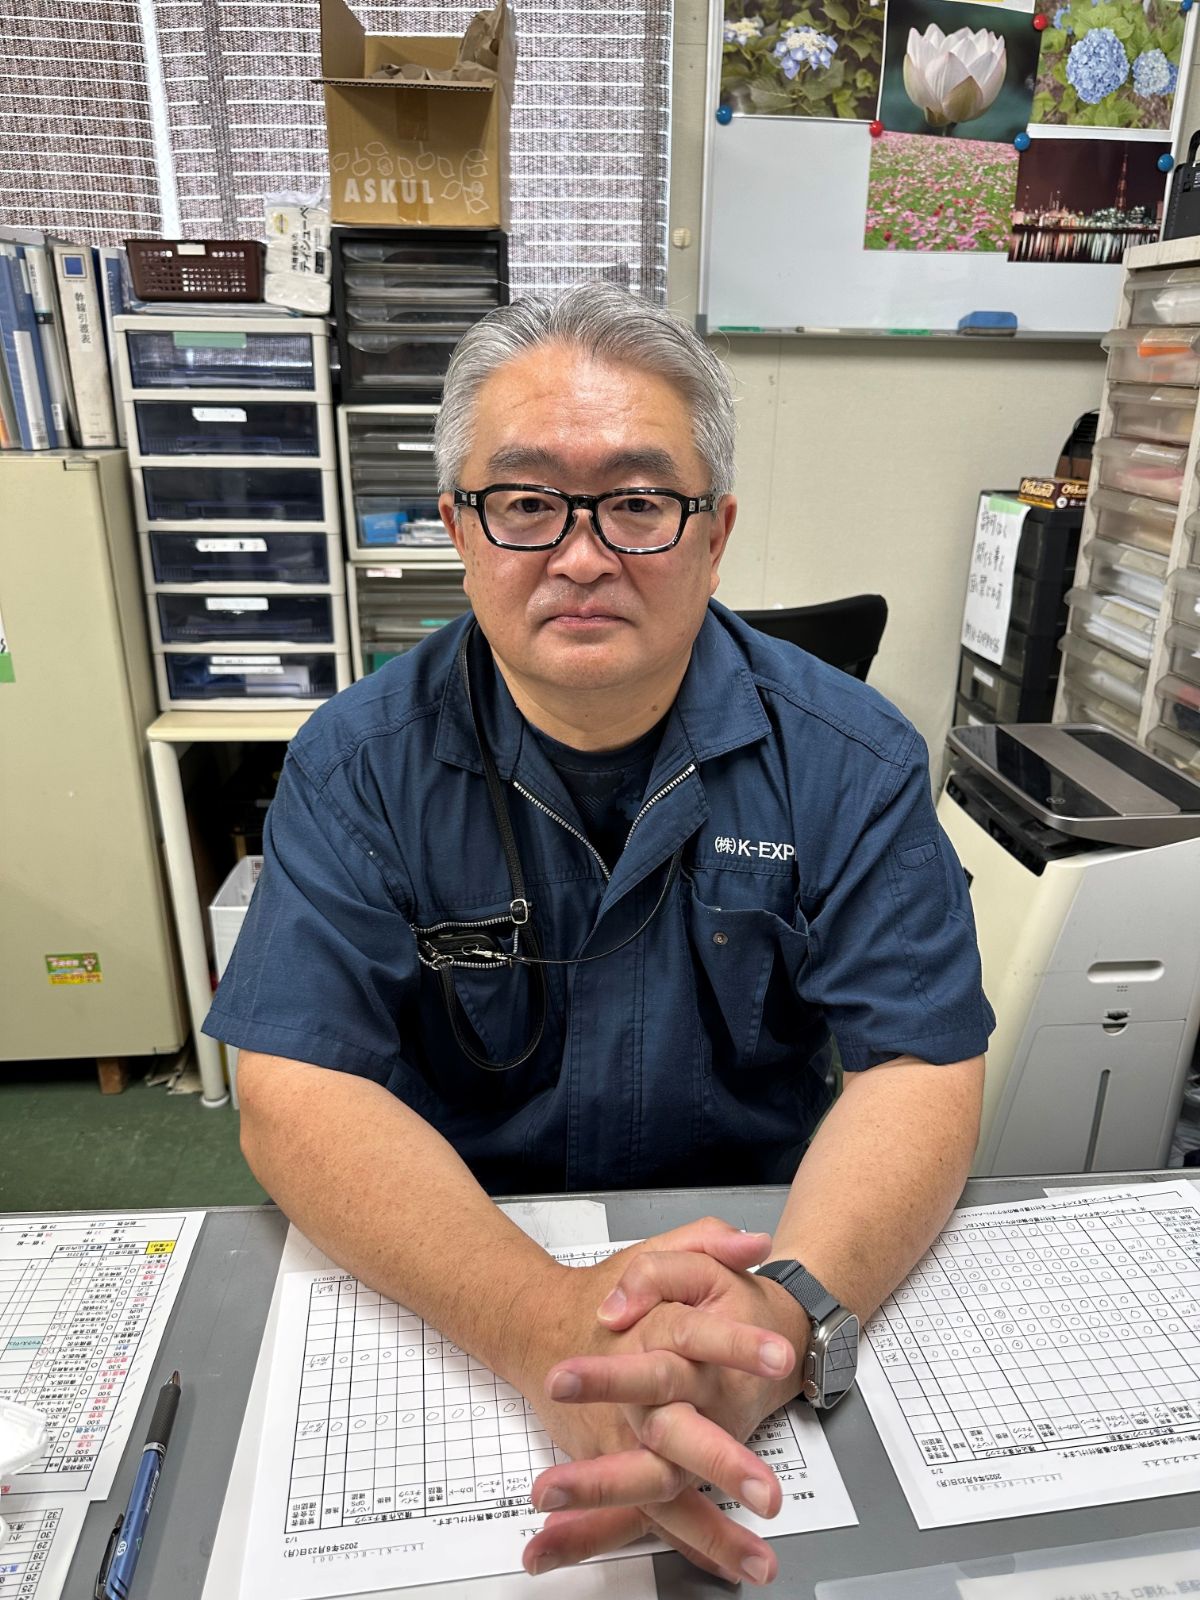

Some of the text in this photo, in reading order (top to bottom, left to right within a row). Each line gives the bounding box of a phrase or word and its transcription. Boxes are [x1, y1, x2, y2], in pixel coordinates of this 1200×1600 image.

[344, 178, 434, 204] ASKUL
[299, 205, 312, 272] ティシューペ
[715, 836, 796, 861] (株)K-EXP
[477, 1479, 501, 1488] チェーン
[398, 1489, 422, 1498] チェック
[428, 1486, 443, 1494] 電話
[792, 1491, 815, 1500] 事業所
[292, 1502, 317, 1510] 確認印
[47, 1511, 59, 1519] 32
[291, 1509, 315, 1518] 立会者
[432, 1507, 537, 1526] 時に確認の義務付けします。
[44, 1520, 55, 1528] 31
[290, 1518, 315, 1527] 管理者
[285, 1536, 298, 1544] 1/3
[36, 1541, 48, 1549] 29
[283, 1541, 359, 1558] 2025年6月23日(月)
[33, 1552, 45, 1560] 28
[29, 1563, 41, 1571] 27
[26, 1573, 37, 1581] 26
[22, 1584, 33, 1592] 25
